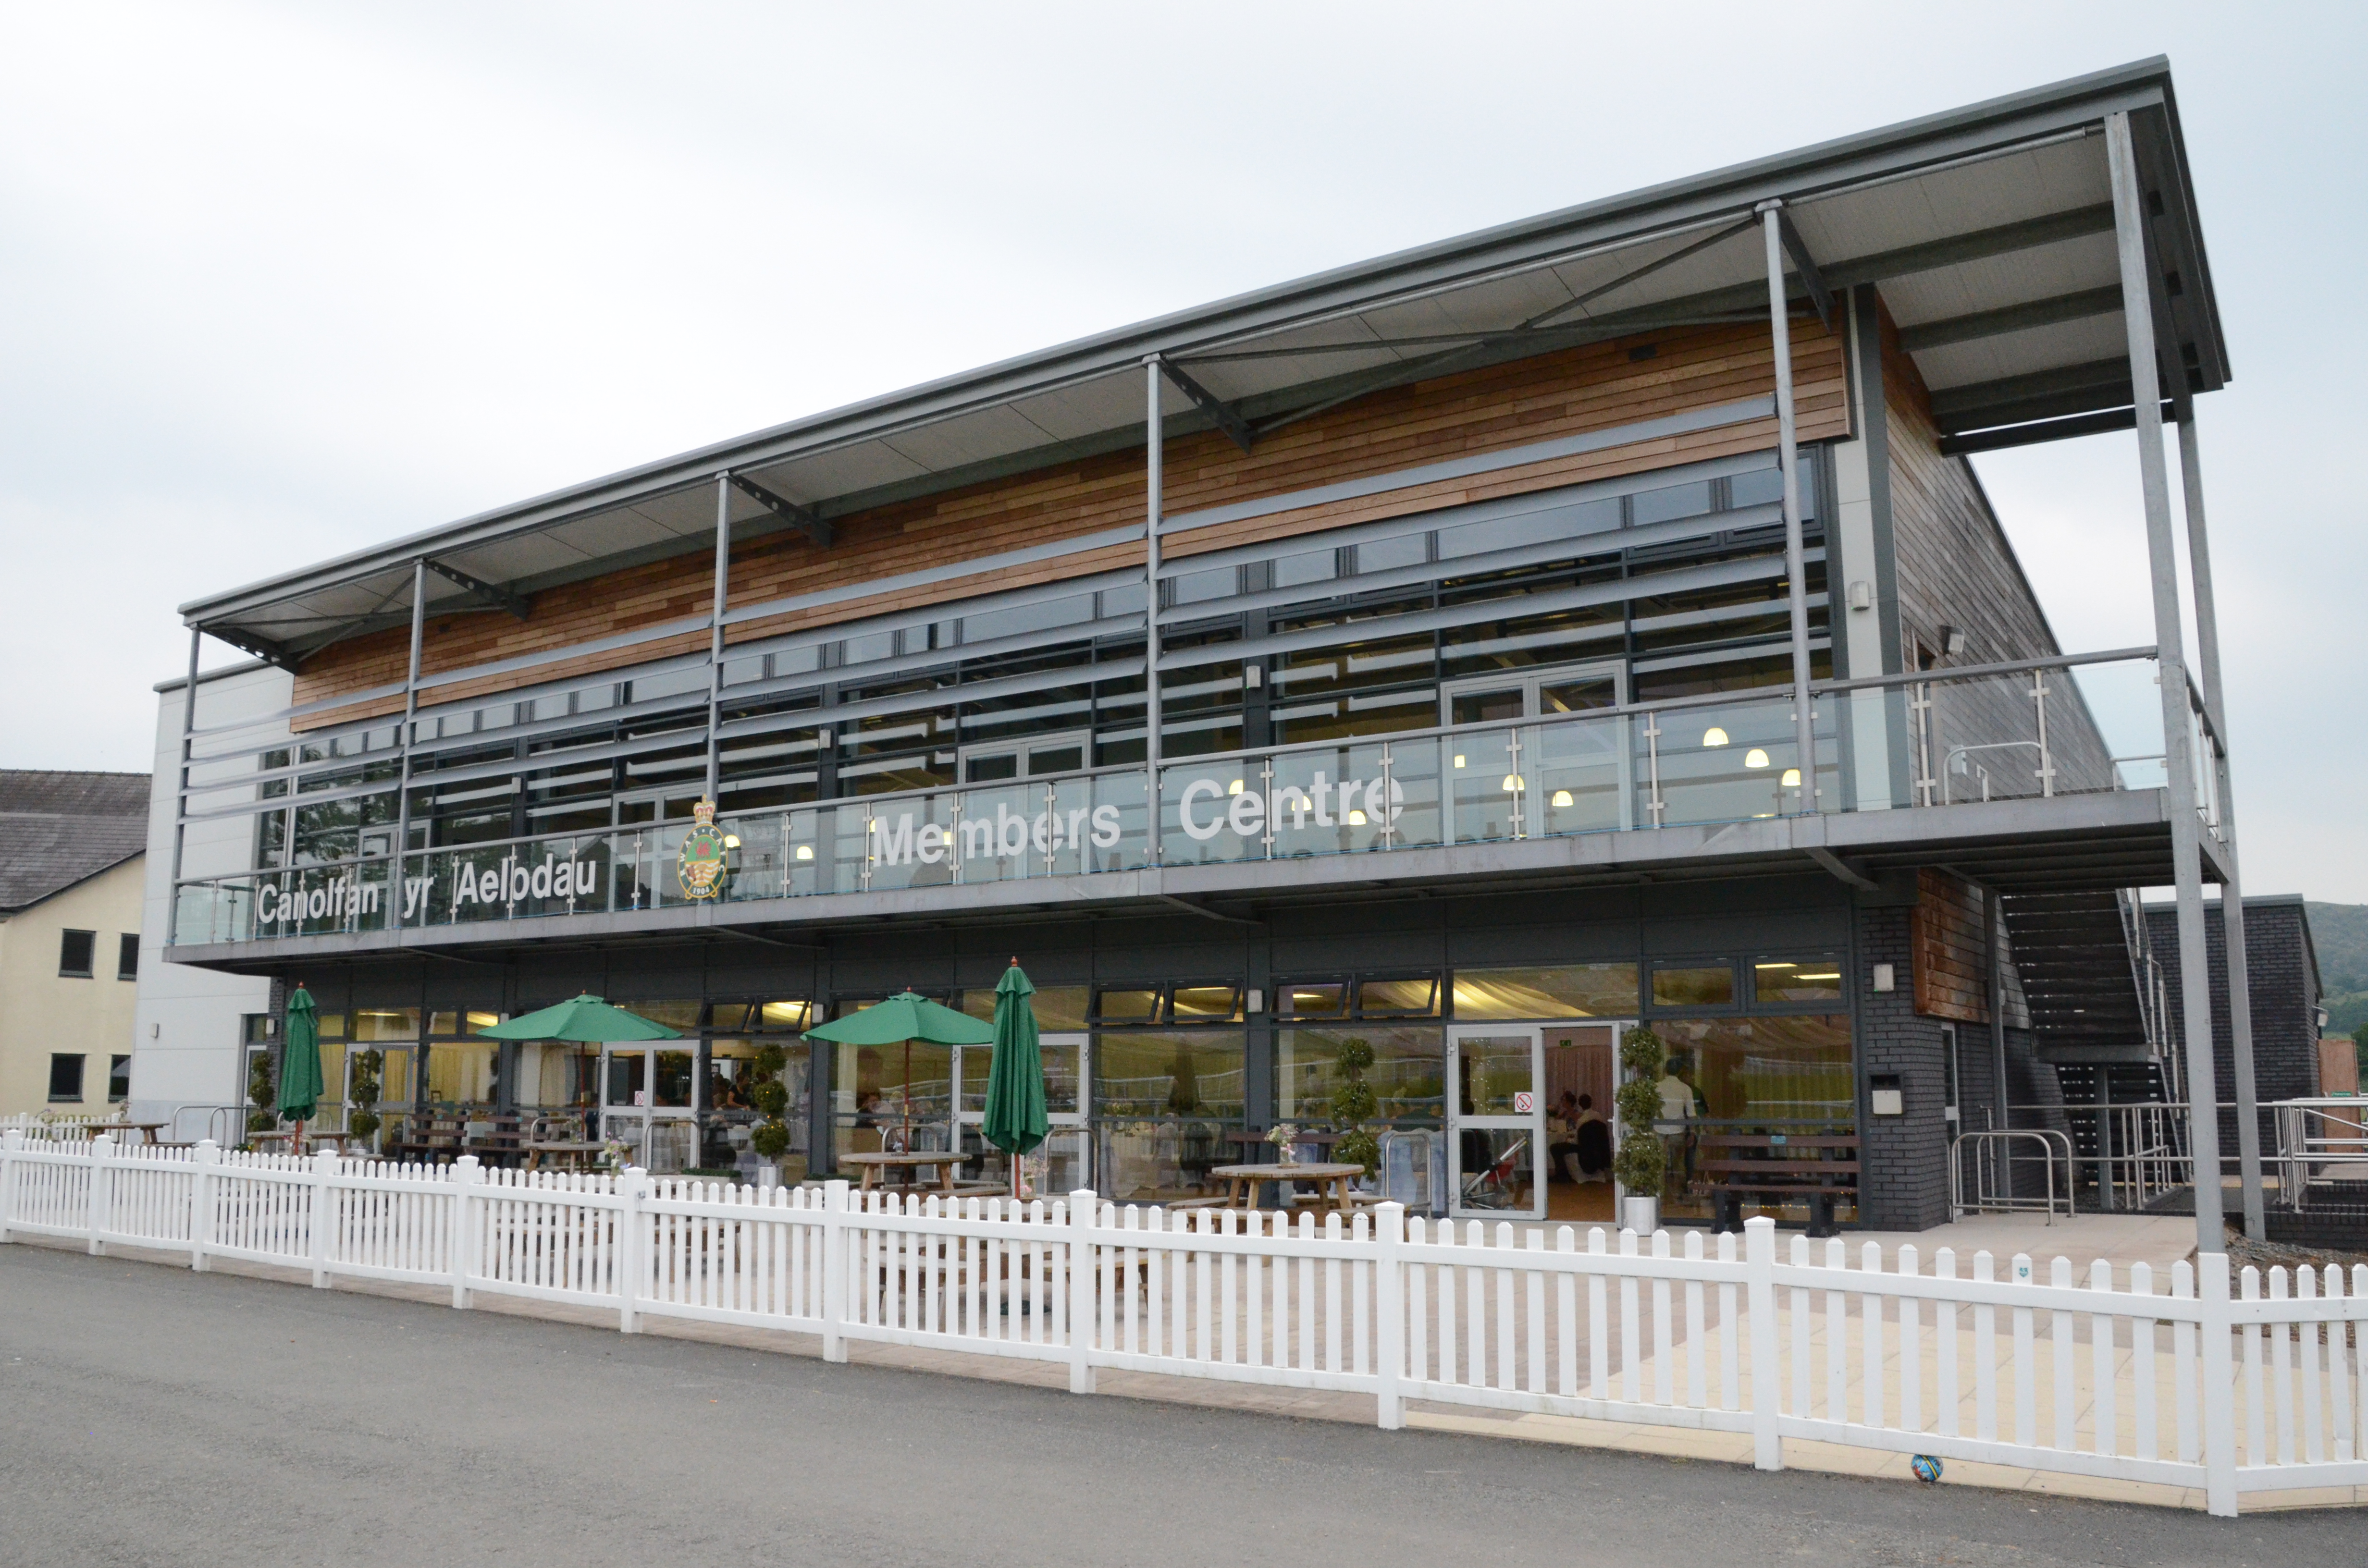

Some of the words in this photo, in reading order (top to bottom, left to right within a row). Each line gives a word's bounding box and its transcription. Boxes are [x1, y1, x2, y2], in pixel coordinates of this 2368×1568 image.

[873, 803, 1121, 867] Members
[1180, 771, 1404, 840] Centre
[258, 876, 378, 923] Canolfan
[404, 877, 433, 919] yr
[456, 853, 596, 905] Aelodau
[692, 886, 710, 895] 1904
